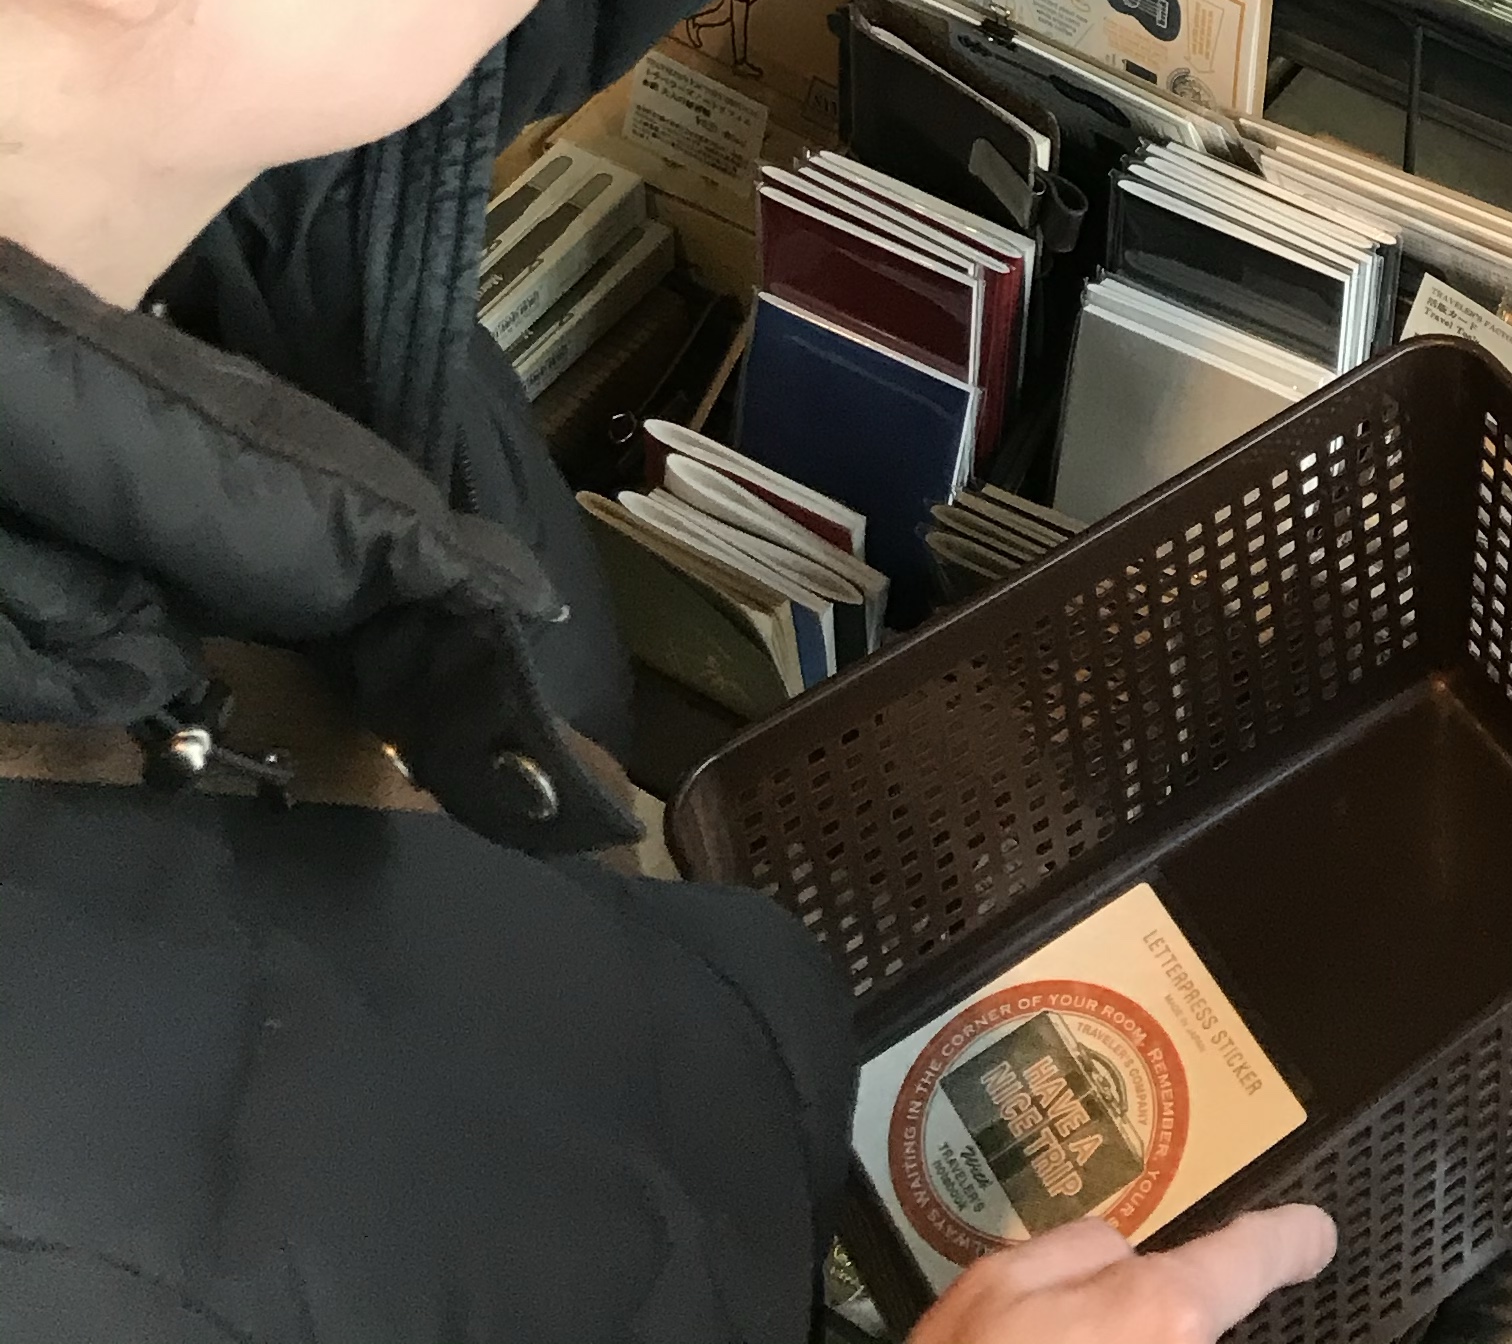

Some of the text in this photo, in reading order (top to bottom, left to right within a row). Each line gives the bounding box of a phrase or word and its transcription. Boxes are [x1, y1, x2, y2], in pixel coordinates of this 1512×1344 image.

[1016, 993, 1045, 1011] OF
[1047, 992, 1099, 1012] YOUR
[1142, 928, 1265, 1099] LETTERPRESS STICKER
[939, 1001, 1013, 1061] CORNER
[914, 1055, 941, 1094] THE
[906, 1095, 920, 1121] IN
[980, 1062, 1084, 1200] NICE TRIP
[1023, 1055, 1105, 1167] HAVE A
[900, 1123, 932, 1208] WAITING
[1120, 1167, 1162, 1221] YOUR
